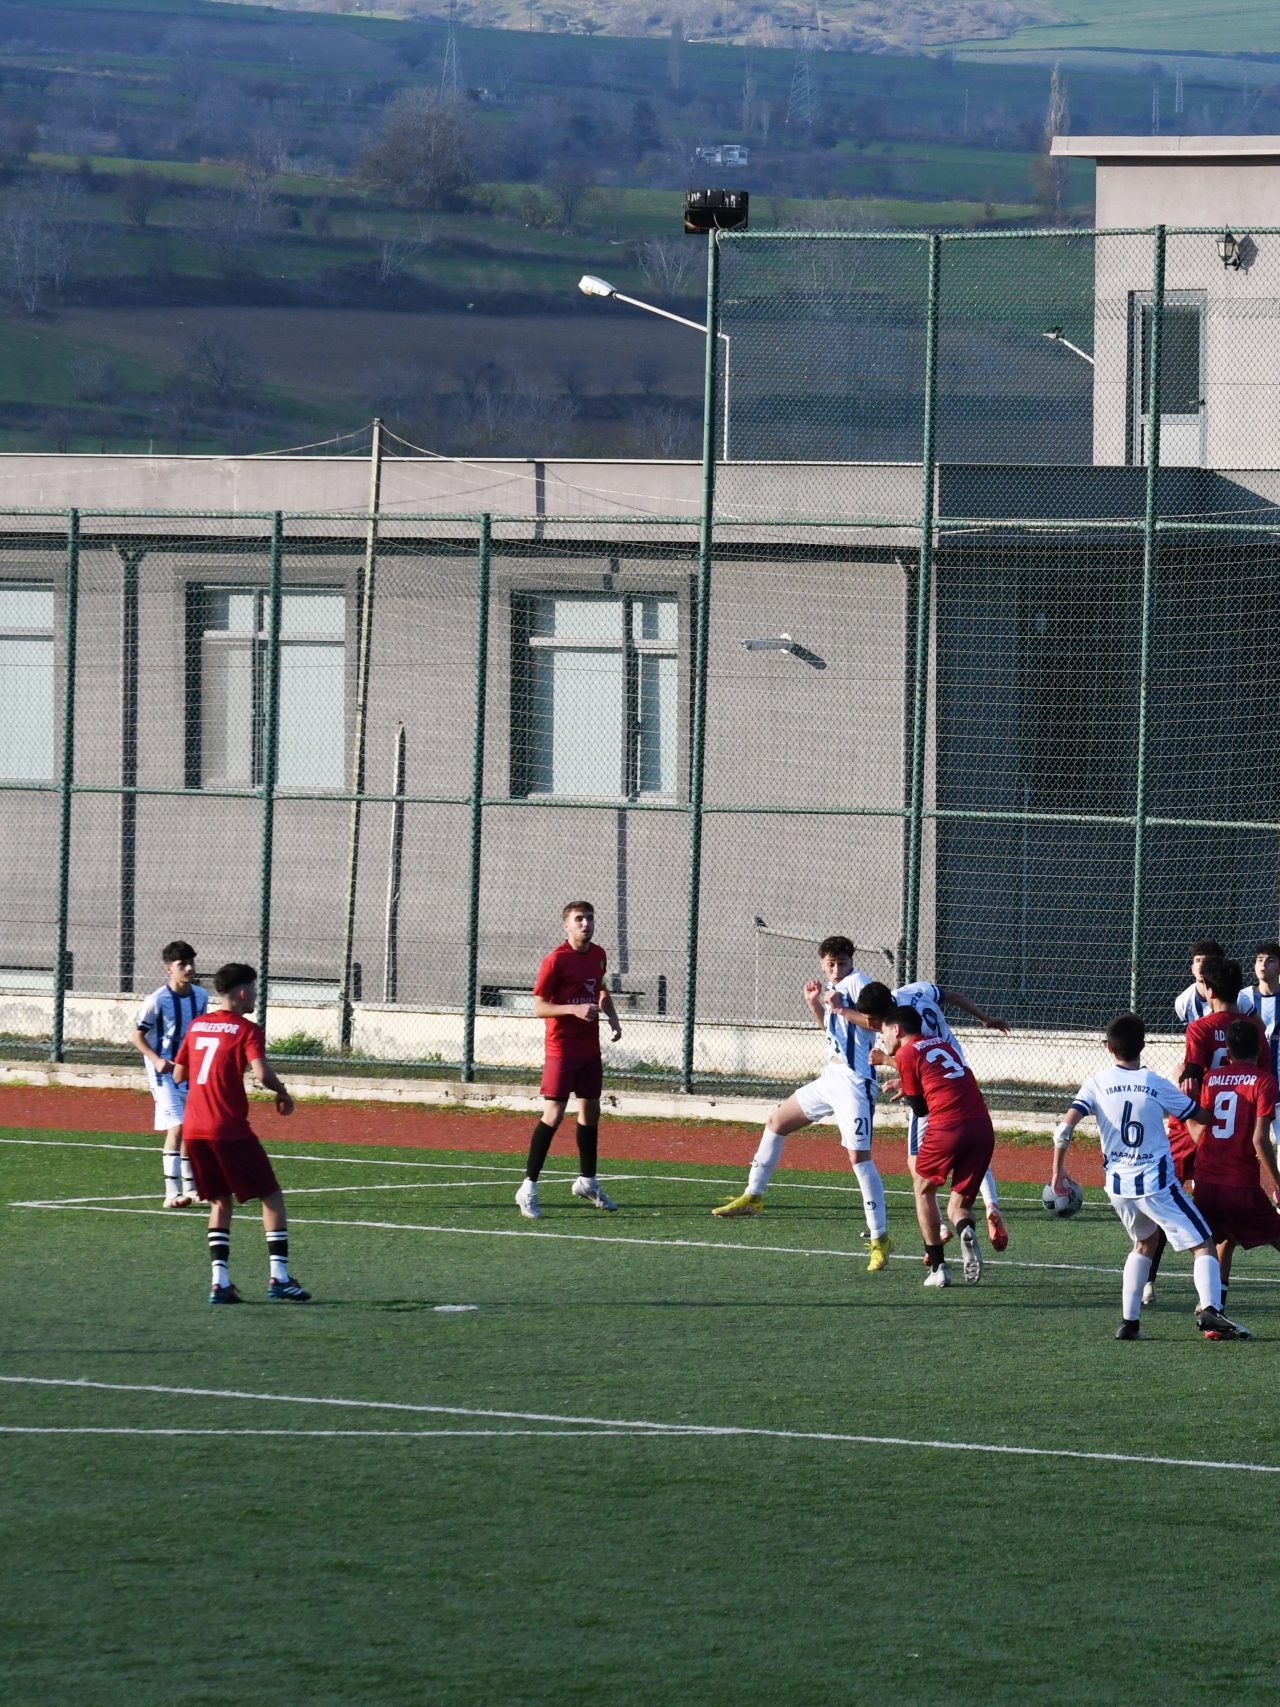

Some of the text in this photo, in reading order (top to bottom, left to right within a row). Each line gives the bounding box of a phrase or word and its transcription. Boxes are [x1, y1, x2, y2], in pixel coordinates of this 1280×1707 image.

[195, 1036, 221, 1085] 7
[925, 1047, 965, 1079] 3
[1133, 1084, 1151, 1095] 2022
[1207, 1073, 1258, 1088] ADALETSPOR
[854, 1118, 868, 1135] 21
[1120, 1100, 1145, 1149] 6
[1212, 1091, 1238, 1138] 9
